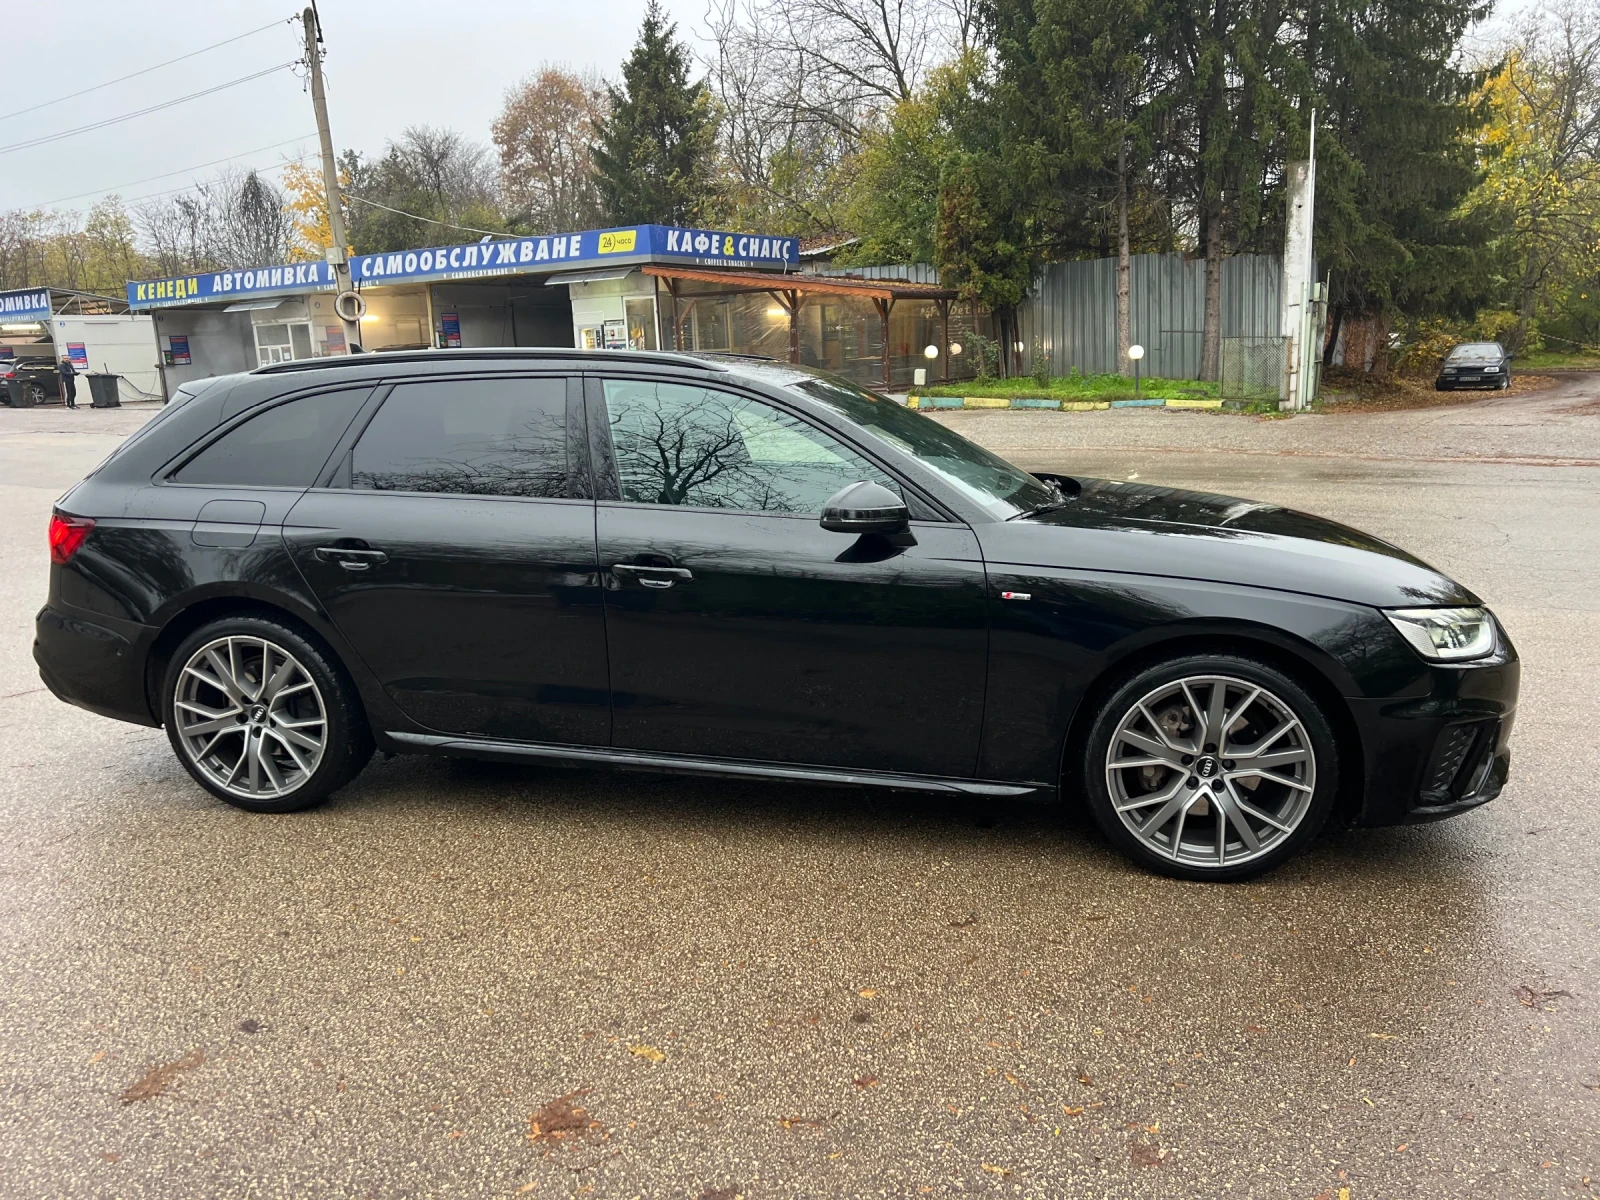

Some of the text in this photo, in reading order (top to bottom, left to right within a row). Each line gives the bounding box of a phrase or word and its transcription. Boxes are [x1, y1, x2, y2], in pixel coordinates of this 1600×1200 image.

[602, 236, 613, 248] 24
[667, 230, 791, 259] КАФЕ & СНАКС
[137, 277, 198, 301] КЕНЕДИ
[213, 264, 319, 292] АВТОМИВКА
[361, 235, 582, 277] САМООБСЛУЖВАНЕ
[451, 267, 508, 279] САМООБСЛУЖВАНЕ
[950, 299, 993, 315] Detils
